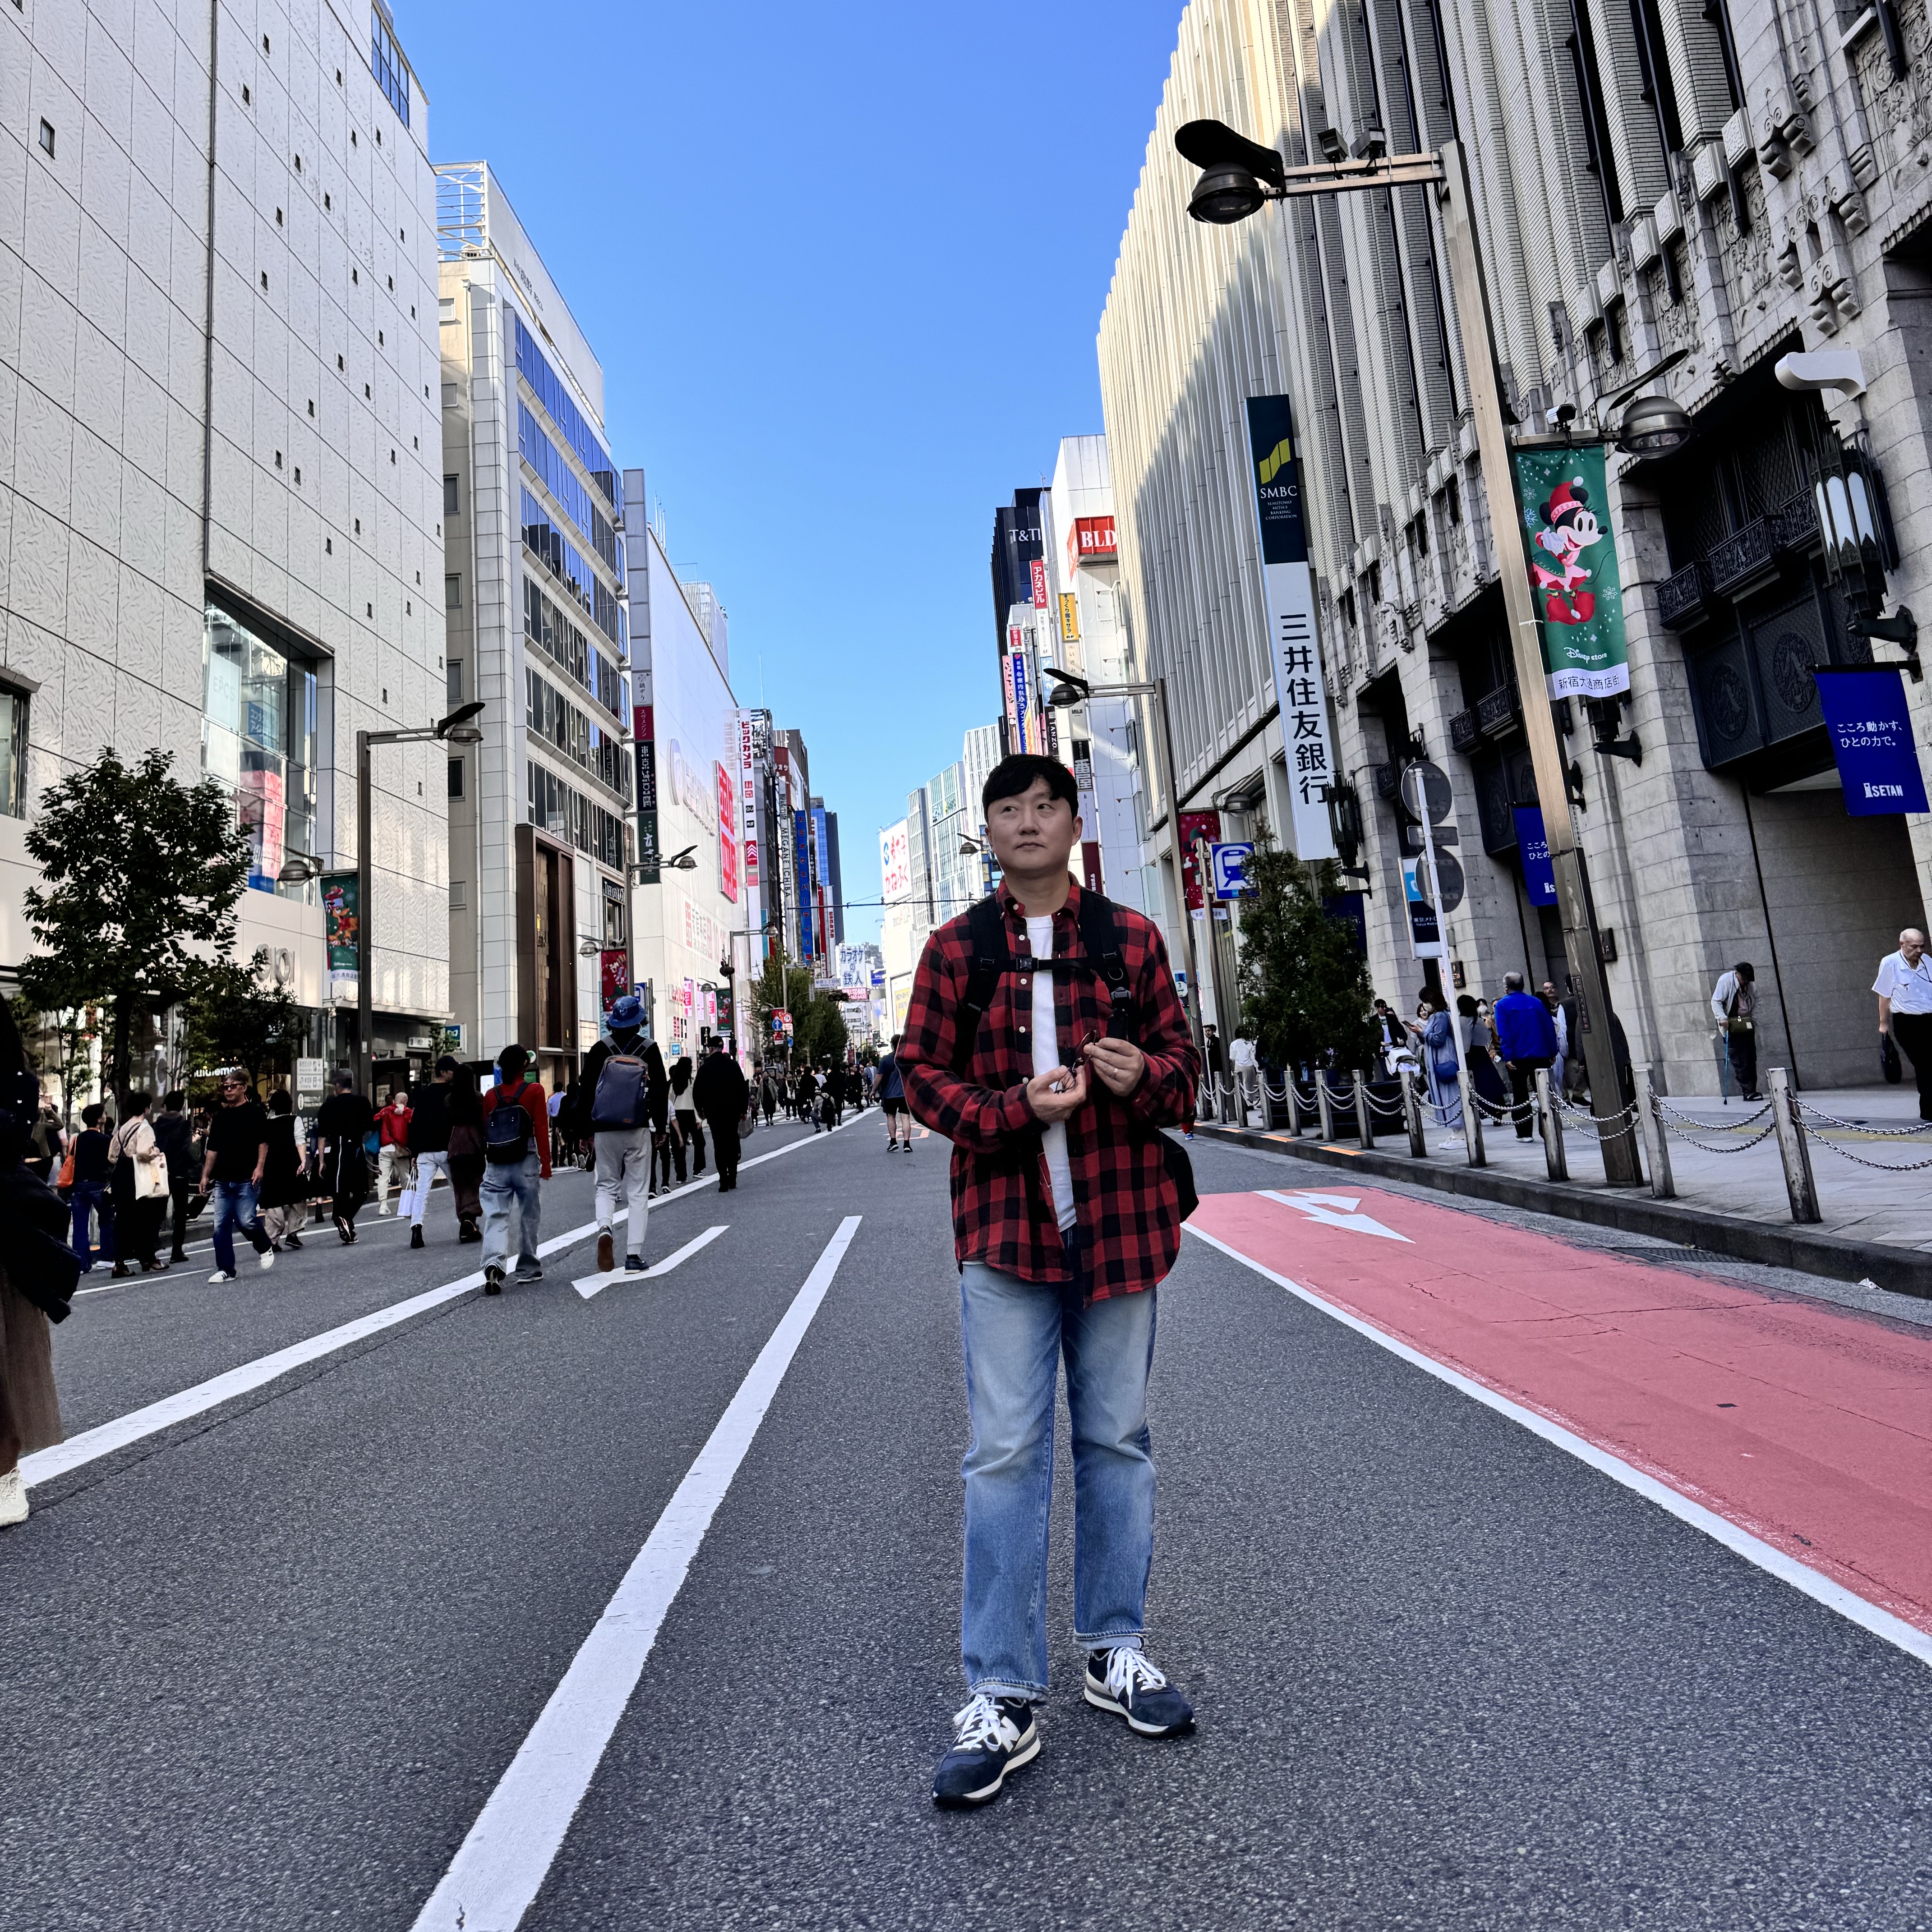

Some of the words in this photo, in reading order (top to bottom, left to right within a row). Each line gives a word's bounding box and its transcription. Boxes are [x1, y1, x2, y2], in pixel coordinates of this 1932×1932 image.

[1260, 486, 1297, 498] SMBC
[1033, 566, 1045, 603] アカネビル
[1591, 652, 1608, 661] store
[1558, 674, 1620, 690] 新宿大通商店街
[1280, 613, 1328, 805] 三井住友銀行
[1837, 720, 1902, 733] こころ動かす、
[1840, 736, 1896, 748] ひとの力で。
[1863, 782, 1904, 798] ISETAN
[781, 827, 789, 864] MEGANE
[840, 948, 864, 963] カラオケ
[850, 963, 856, 973] の
[844, 971, 864, 987] 鉄人
